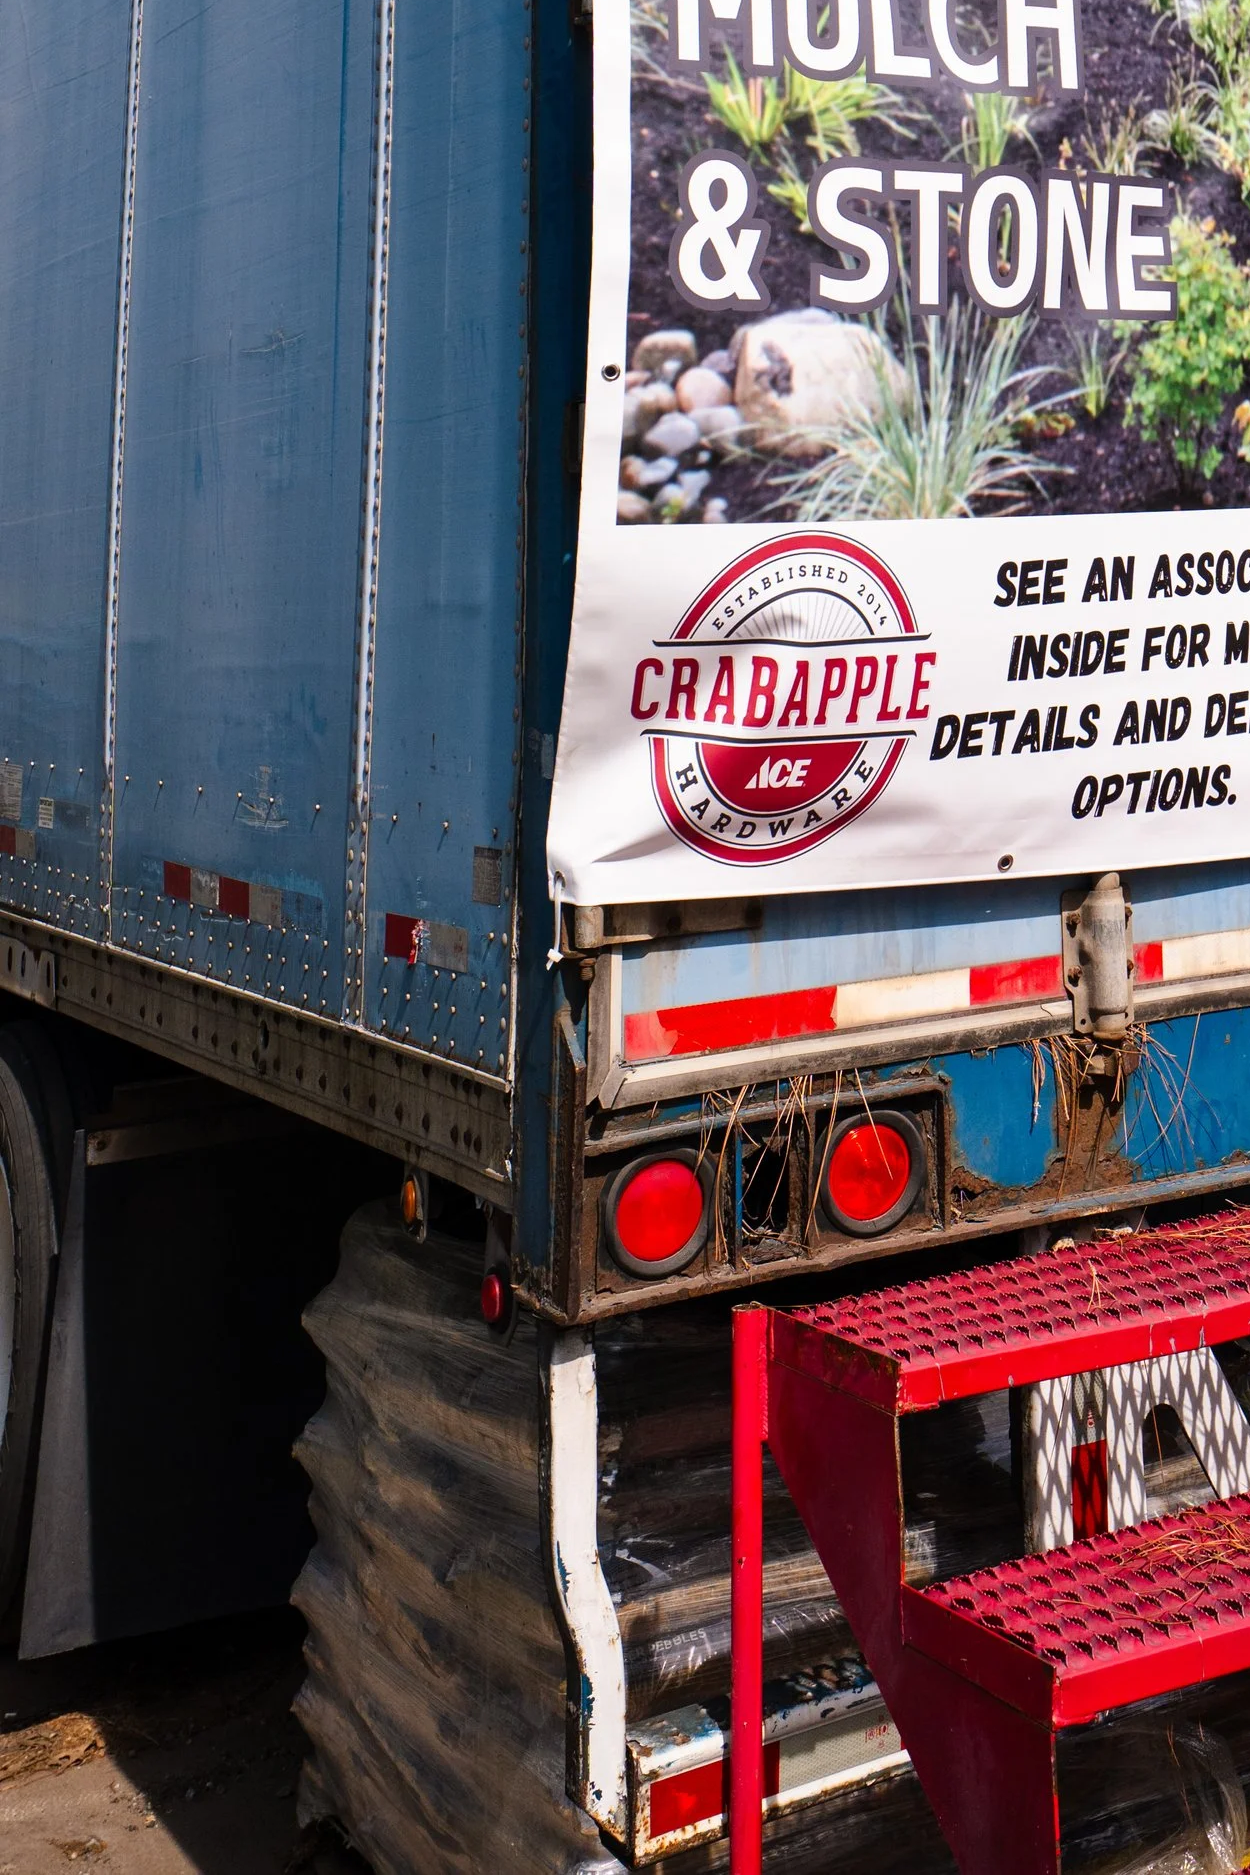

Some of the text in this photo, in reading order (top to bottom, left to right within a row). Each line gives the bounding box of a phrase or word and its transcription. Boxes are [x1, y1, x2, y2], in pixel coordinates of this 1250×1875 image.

[678, 158, 1172, 312] & STONE
[711, 564, 888, 631] ESTABLISHED 2014
[993, 558, 1068, 608] SEE
[1081, 555, 1136, 603] AN
[1007, 628, 1130, 682] INSIDE
[1141, 623, 1210, 672] FOR
[630, 651, 938, 731] CRABAPPLE
[929, 703, 1101, 761] DETAILS
[1112, 696, 1192, 746] AND
[675, 758, 875, 840] HARDWARE
[744, 755, 812, 790] ACE
[1071, 764, 1238, 820] OPTIONS.
[650, 1628, 707, 1651] PEBBLES
